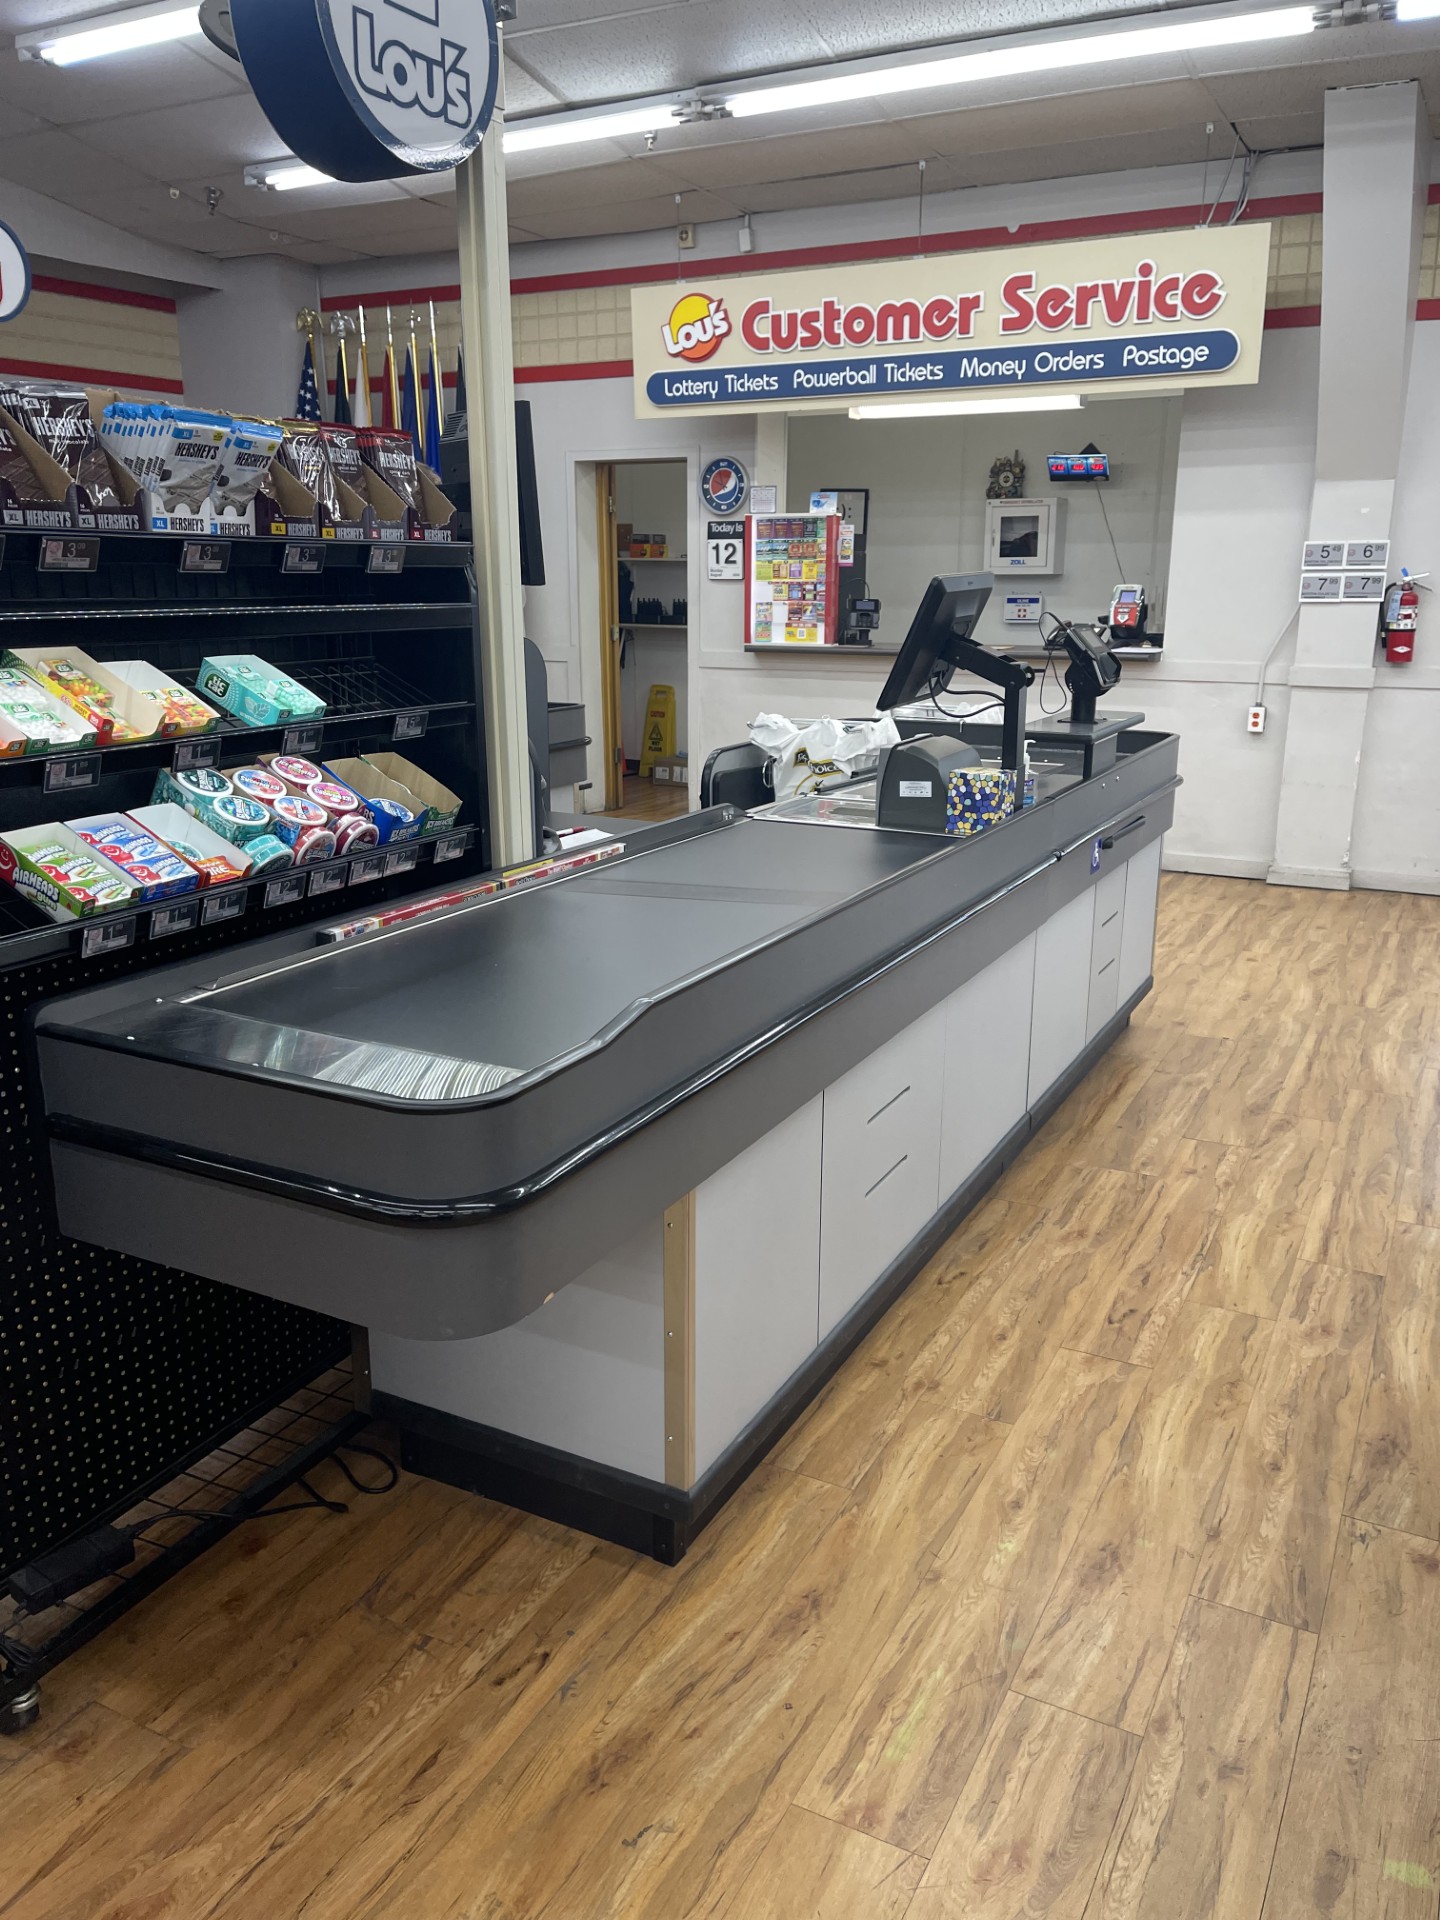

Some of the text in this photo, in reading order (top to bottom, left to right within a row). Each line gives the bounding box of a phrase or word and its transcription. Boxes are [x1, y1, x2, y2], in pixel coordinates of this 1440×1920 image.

[741, 258, 1226, 354] Customer Service
[664, 345, 1210, 399] Lottery Tickets Powerball Tickets Money Orders Postage
[174, 442, 220, 460] HERSHEY'S
[234, 451, 271, 469] HERSHEY'S
[8, 510, 71, 527] XL HERSHEY'S
[81, 514, 140, 529] XL HERSHEY'S
[156, 517, 205, 532] XL HERSHEY'S
[220, 523, 251, 535] HERSHEY'S
[288, 523, 317, 537] HERSHEY'S
[336, 527, 364, 540] HERSHEY'S
[424, 529, 452, 541] HERSHEY'S
[710, 523, 743, 535] Today Is
[67, 543, 76, 558] 3
[203, 546, 212, 561] 3
[302, 548, 310, 562] 3
[384, 550, 392, 562] 3
[712, 543, 737, 564] 12
[1320, 545, 1330, 559] 5
[1363, 544, 1373, 558] 6
[1318, 578, 1328, 591] 7
[1361, 577, 1371, 590] 7
[208, 680, 225, 697] tac
[213, 675, 227, 690] tic
[12, 866, 60, 902] AIRHEADS
[36, 891, 58, 912] gum
